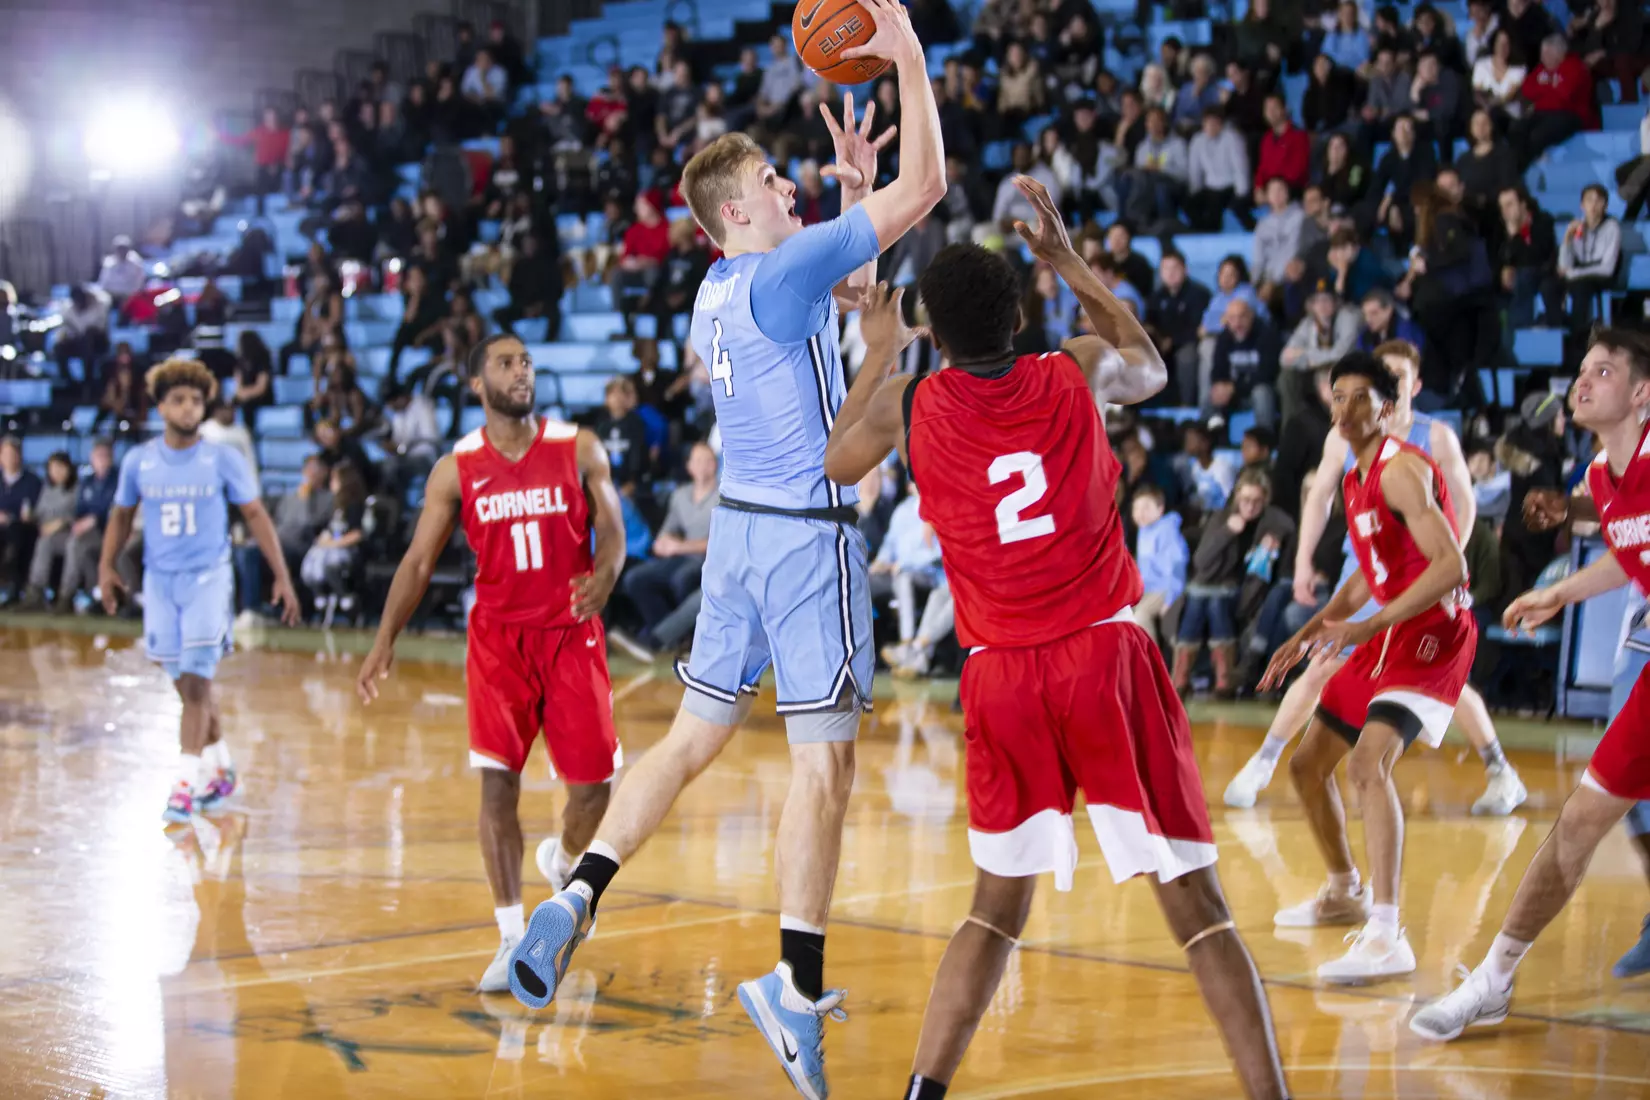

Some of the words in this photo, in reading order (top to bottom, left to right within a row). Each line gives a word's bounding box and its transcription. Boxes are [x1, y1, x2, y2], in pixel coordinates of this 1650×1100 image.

[711, 317, 734, 398] 4
[160, 502, 197, 537] 21
[475, 486, 568, 523] CORNELL
[987, 451, 1056, 544] 2
[510, 520, 544, 572] 11
